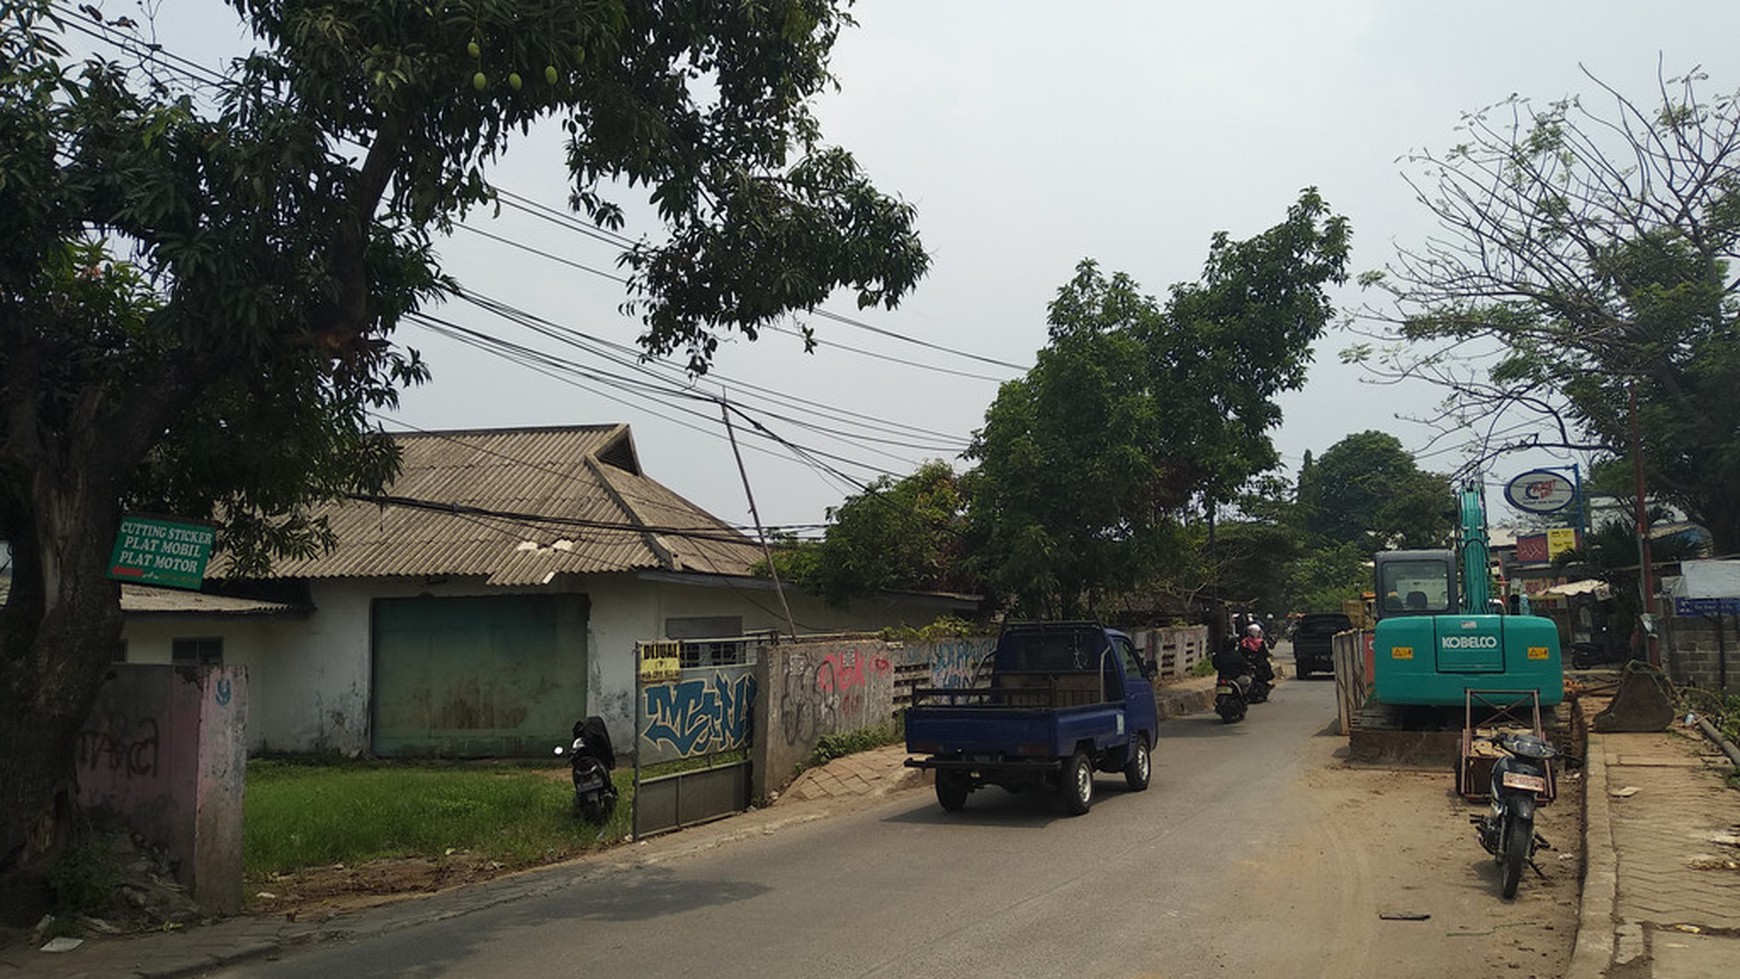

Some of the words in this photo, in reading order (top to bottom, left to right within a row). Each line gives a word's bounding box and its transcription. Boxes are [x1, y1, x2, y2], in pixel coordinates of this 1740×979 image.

[120, 521, 167, 538] CUTTING
[168, 527, 213, 545] STICKER
[123, 536, 160, 551] PLAT
[161, 541, 202, 557] MOBIL
[119, 551, 154, 566] PLAT
[154, 555, 198, 573] MOTOR
[1441, 636, 1498, 649] KOBELCO
